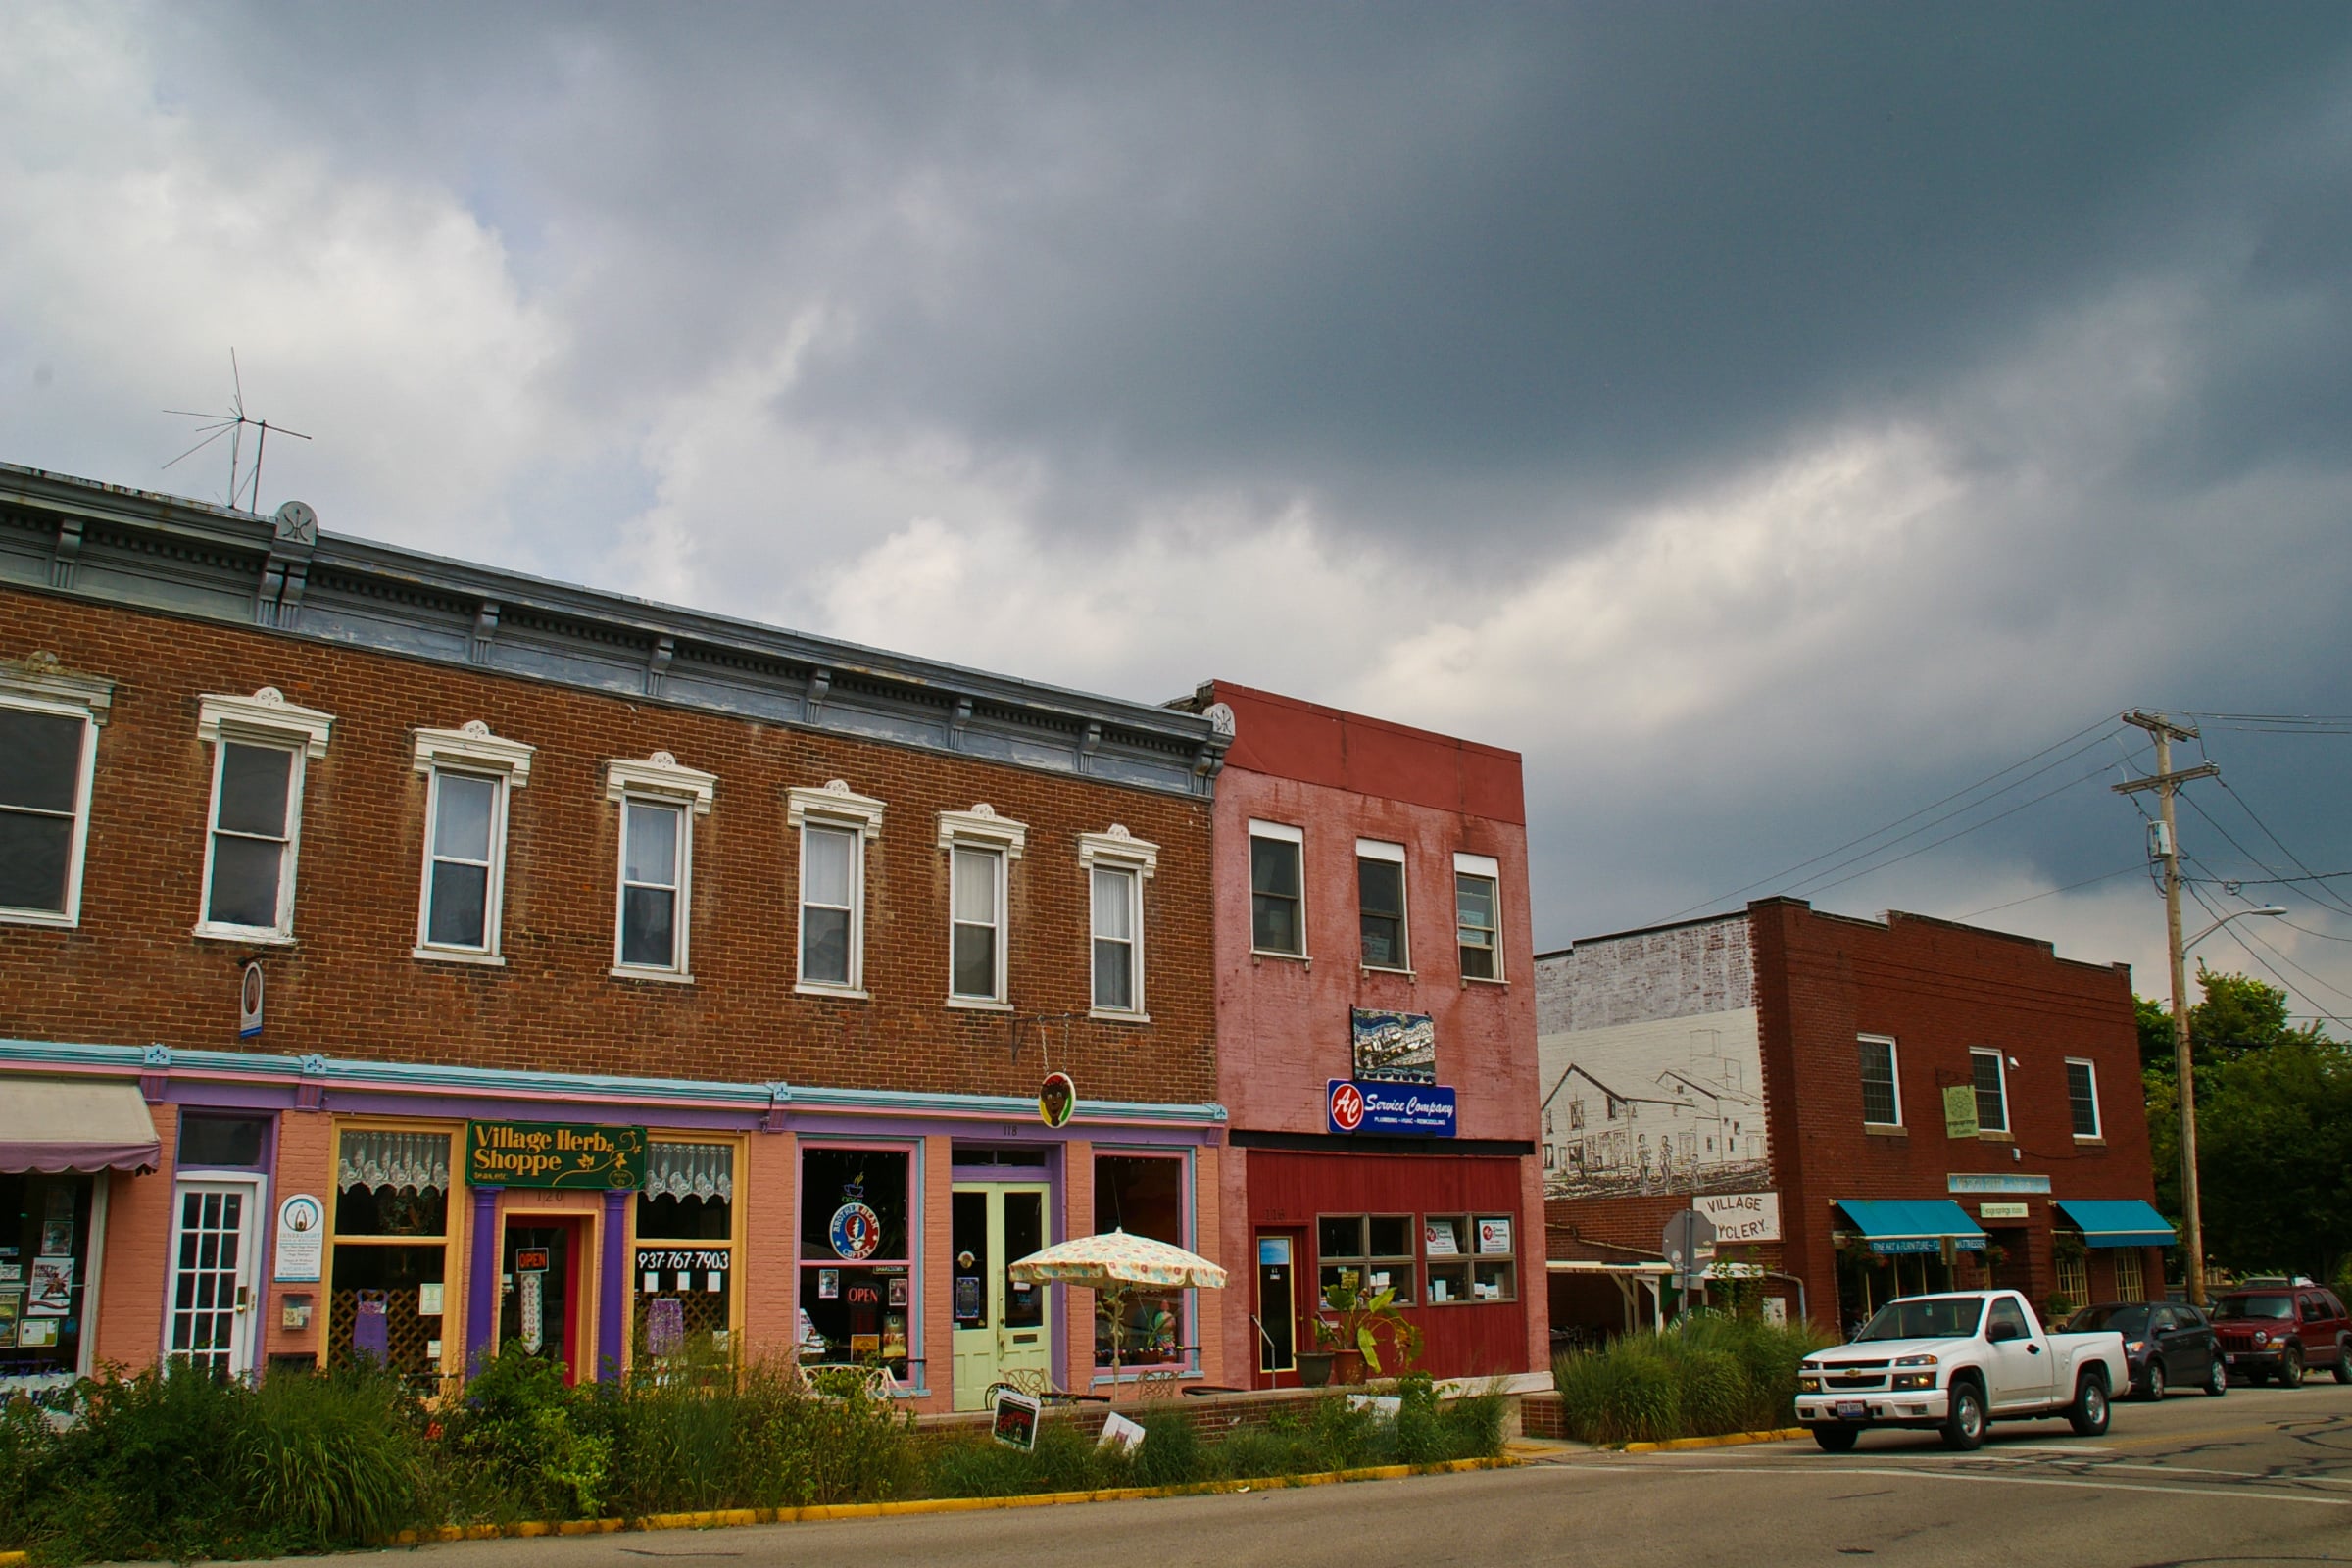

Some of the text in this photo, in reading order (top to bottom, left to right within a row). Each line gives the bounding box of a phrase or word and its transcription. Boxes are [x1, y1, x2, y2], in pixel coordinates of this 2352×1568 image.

[1334, 1088, 1360, 1124] AC
[1363, 1093, 1454, 1119] Service Company
[475, 1125, 608, 1154] Village Herb
[1004, 1125, 1018, 1137] 118
[473, 1148, 563, 1176] Shoppe
[537, 1190, 564, 1201] 120
[1707, 1196, 1763, 1213] VILLAGE
[1716, 1219, 1766, 1239] YCLERY
[519, 1252, 547, 1268] OPEN
[638, 1250, 729, 1270] 937-767-7903
[848, 1287, 879, 1303] OPEN
